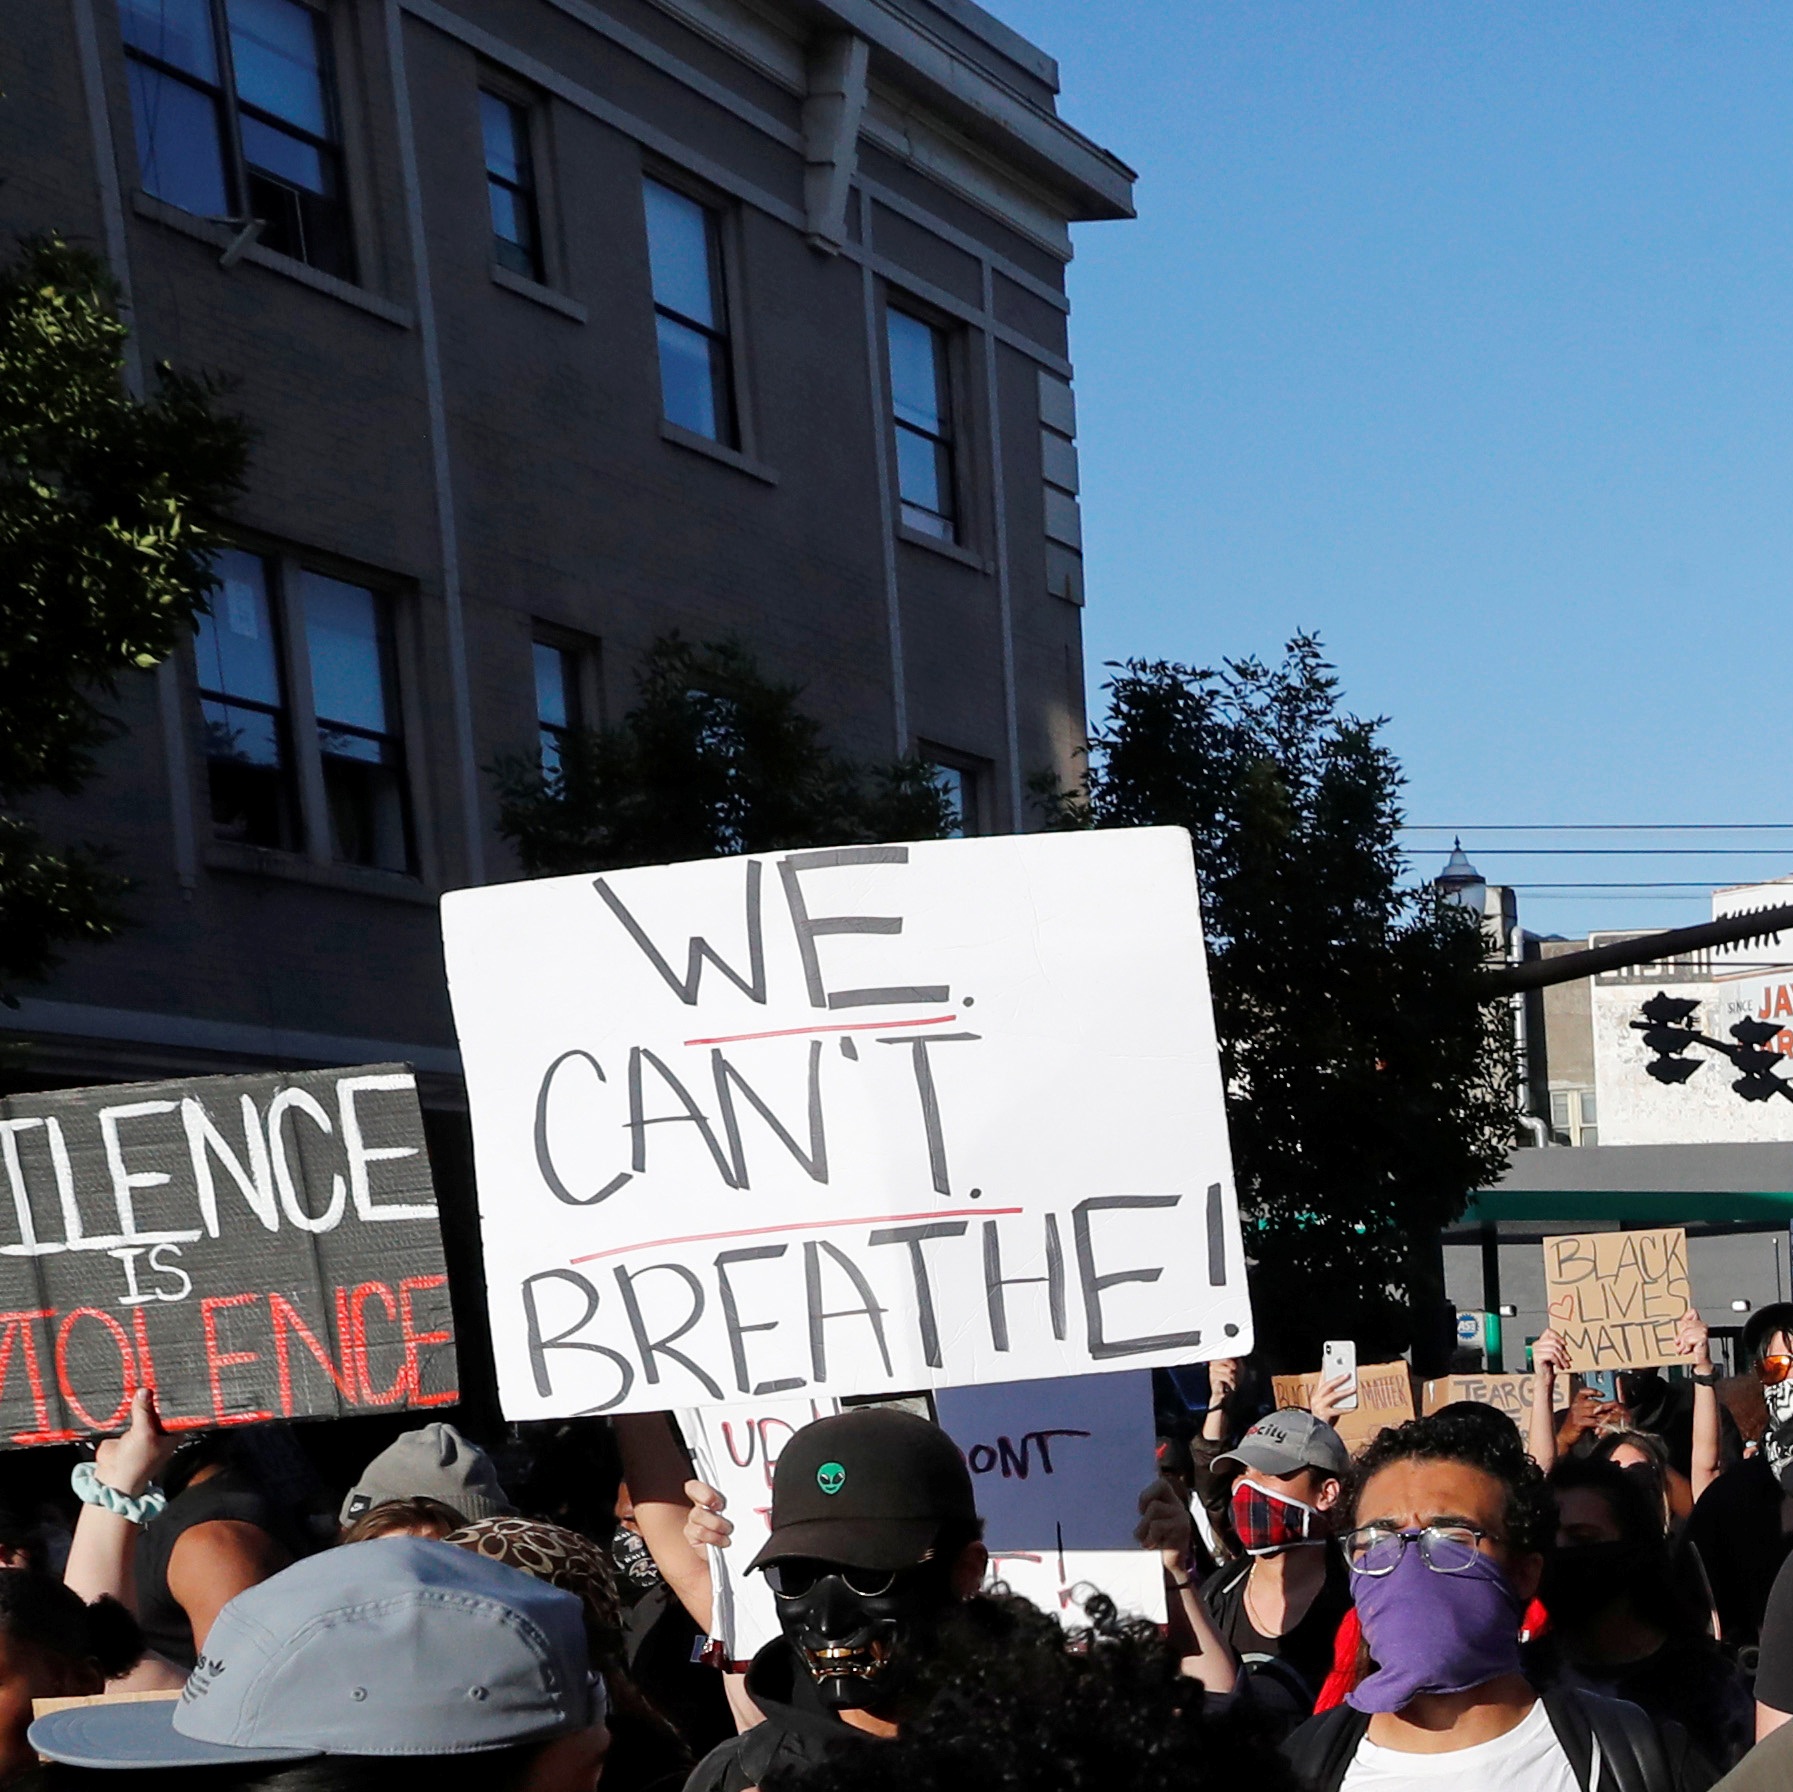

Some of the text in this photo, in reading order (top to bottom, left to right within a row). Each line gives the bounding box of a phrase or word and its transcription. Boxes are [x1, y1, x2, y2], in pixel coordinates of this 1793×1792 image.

[593, 846, 975, 1010] WE.
[1727, 1000, 1754, 1016] SINCE
[533, 1031, 983, 1206] CAN'T.
[0, 1075, 437, 1256] ILENCE
[109, 1244, 192, 1307] IS
[1550, 1232, 1688, 1286] BLACK
[523, 1183, 1240, 1416] BREATHE!
[1577, 1277, 1688, 1324] LIVES
[1453, 1376, 1565, 1411] TEARGS
[957, 1428, 1092, 1480] ONT
